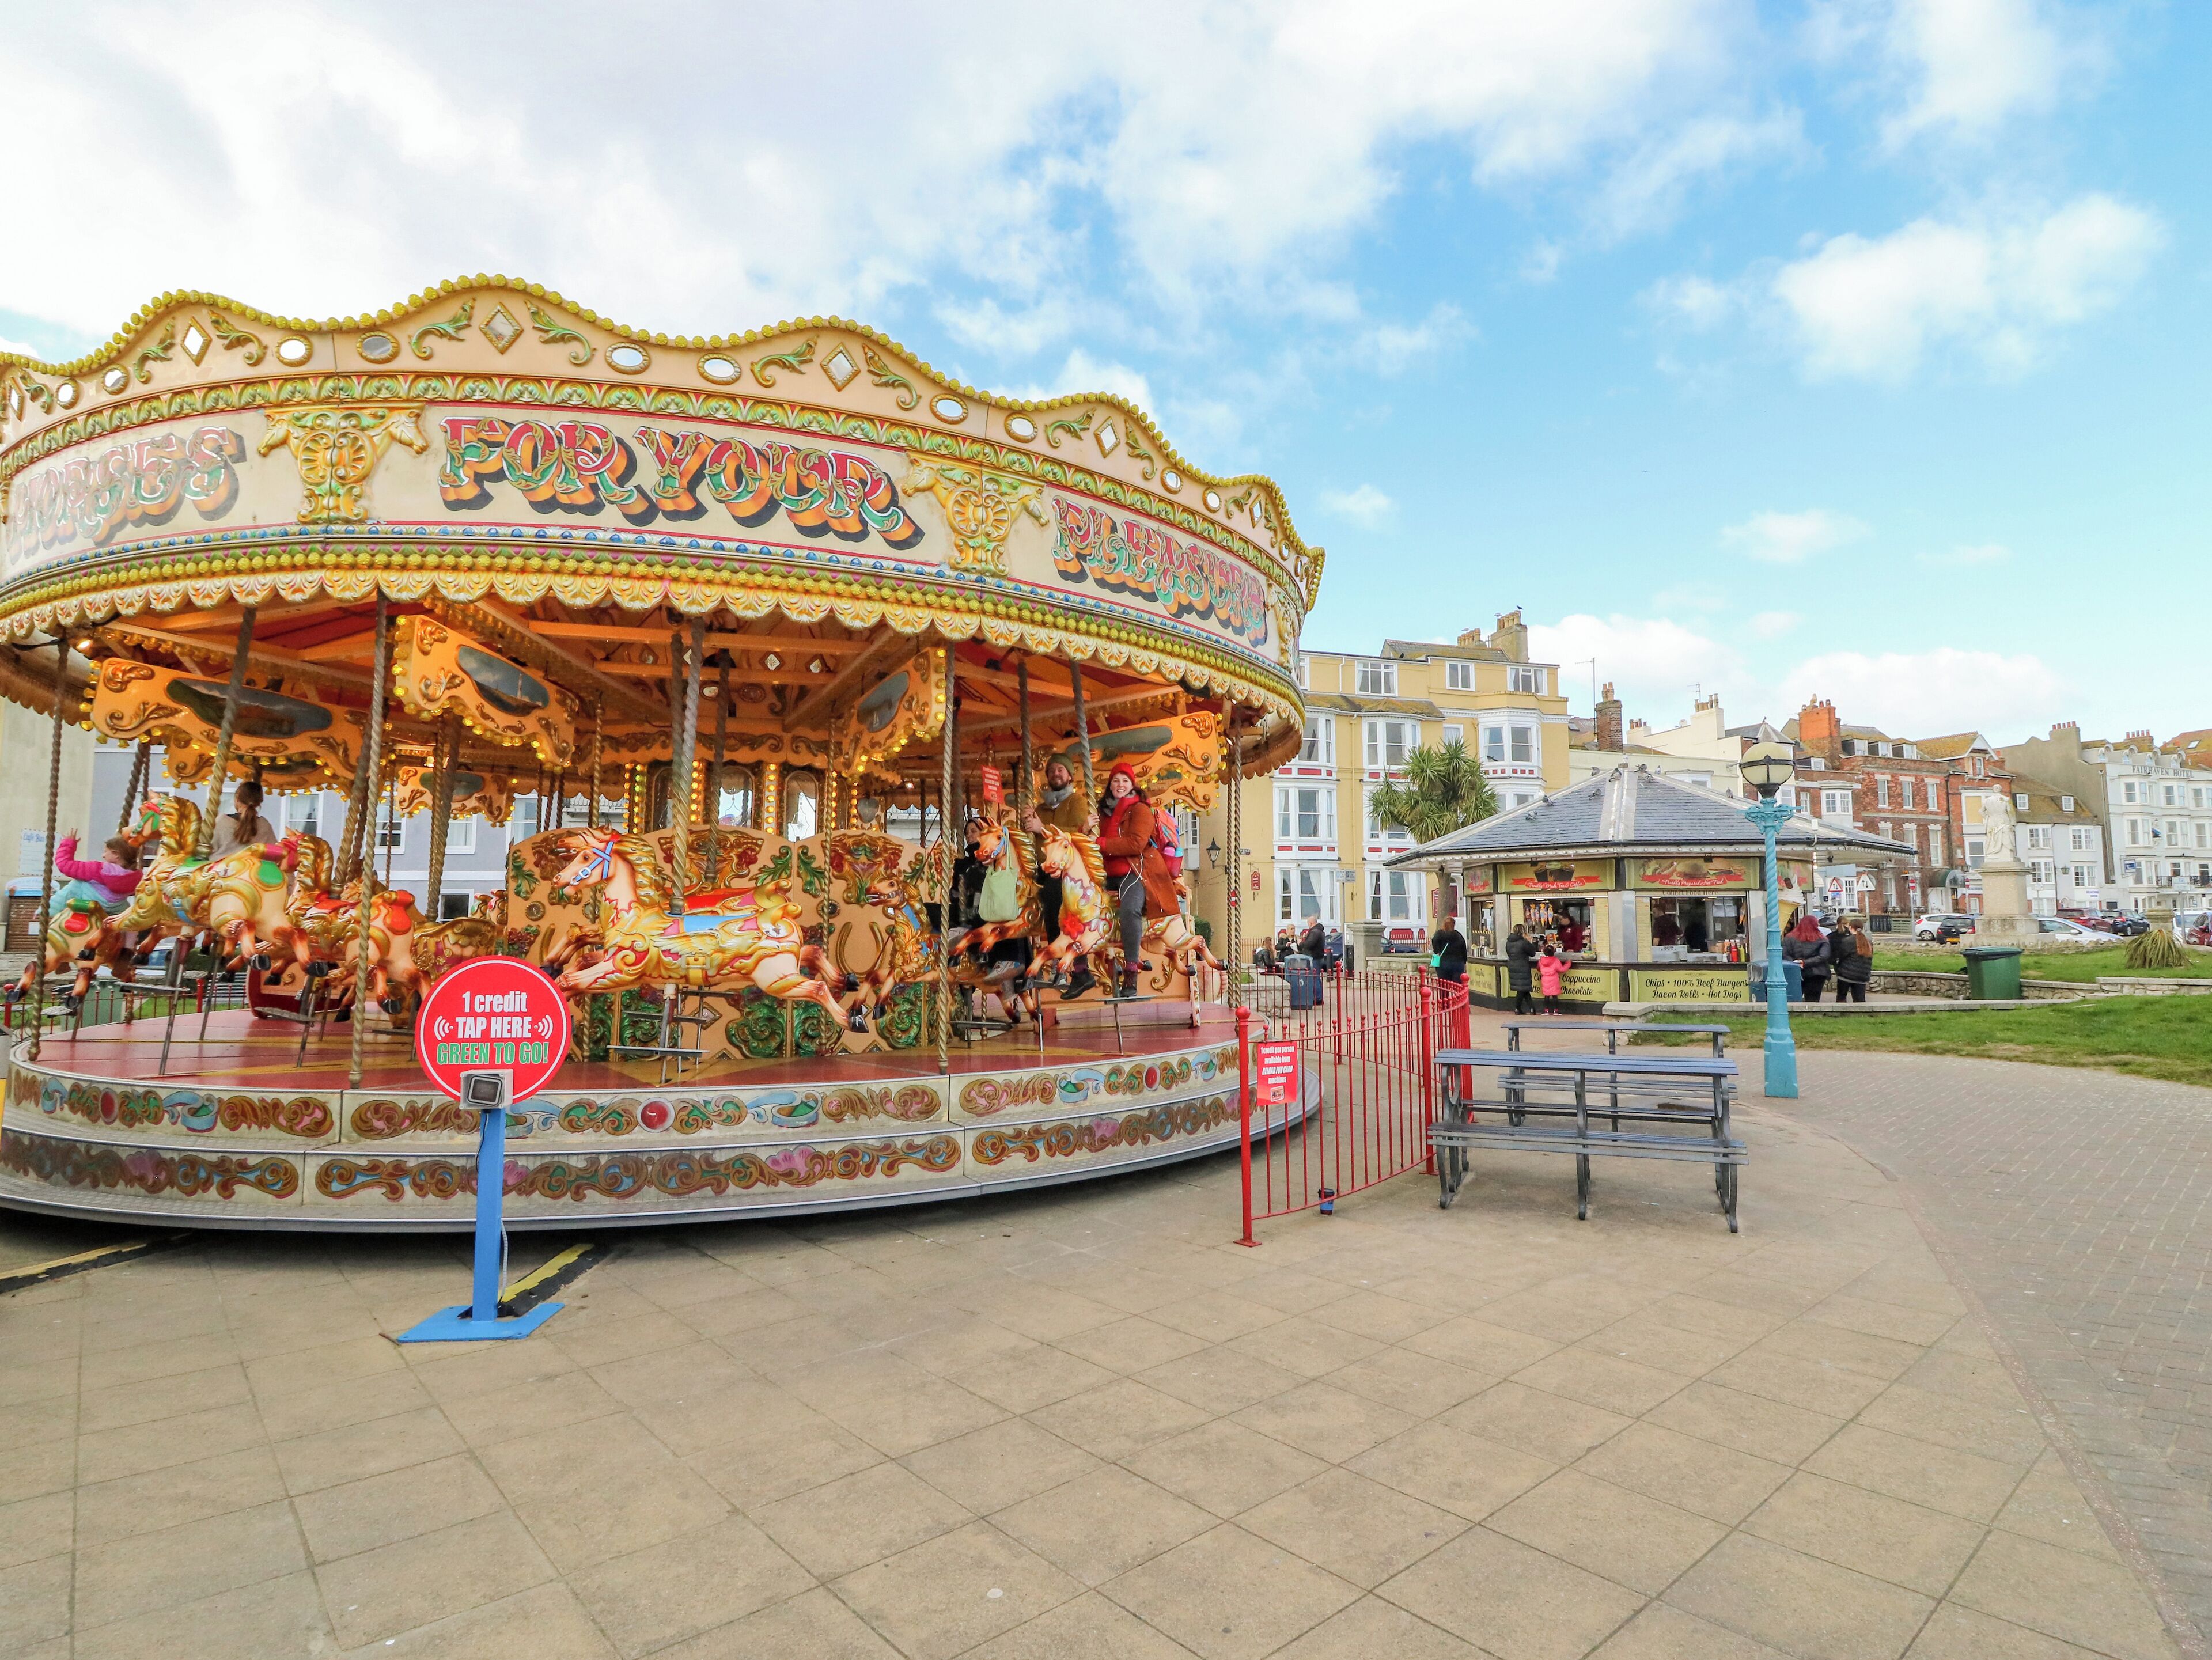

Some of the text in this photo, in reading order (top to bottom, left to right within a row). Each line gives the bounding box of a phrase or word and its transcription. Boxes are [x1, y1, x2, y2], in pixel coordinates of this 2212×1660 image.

[438, 416, 926, 551] FOR YOUR
[1051, 495, 1268, 648] PLEASURE
[2132, 764, 2194, 778] FAIRHAVEN HOTEL
[1562, 973, 1601, 986] Cappuccino
[1645, 978, 1665, 989] Chips
[1696, 978, 1715, 990] Beef
[1716, 979, 1748, 990] Burgers
[1560, 986, 1593, 996] Chocolate
[1652, 990, 1742, 1001] Bacon Rolls Hot Dogs
[462, 990, 528, 1013] 1 credit
[456, 1016, 532, 1039] TAP HERE
[437, 1041, 550, 1065] GREEN TO GO!
[1263, 1046, 1275, 1054] credit
[1282, 1045, 1295, 1053] person
[1264, 1055, 1291, 1064] available from
[1262, 1065, 1294, 1075] RELOAD FUN CARD
[1268, 1076, 1287, 1084] machines
